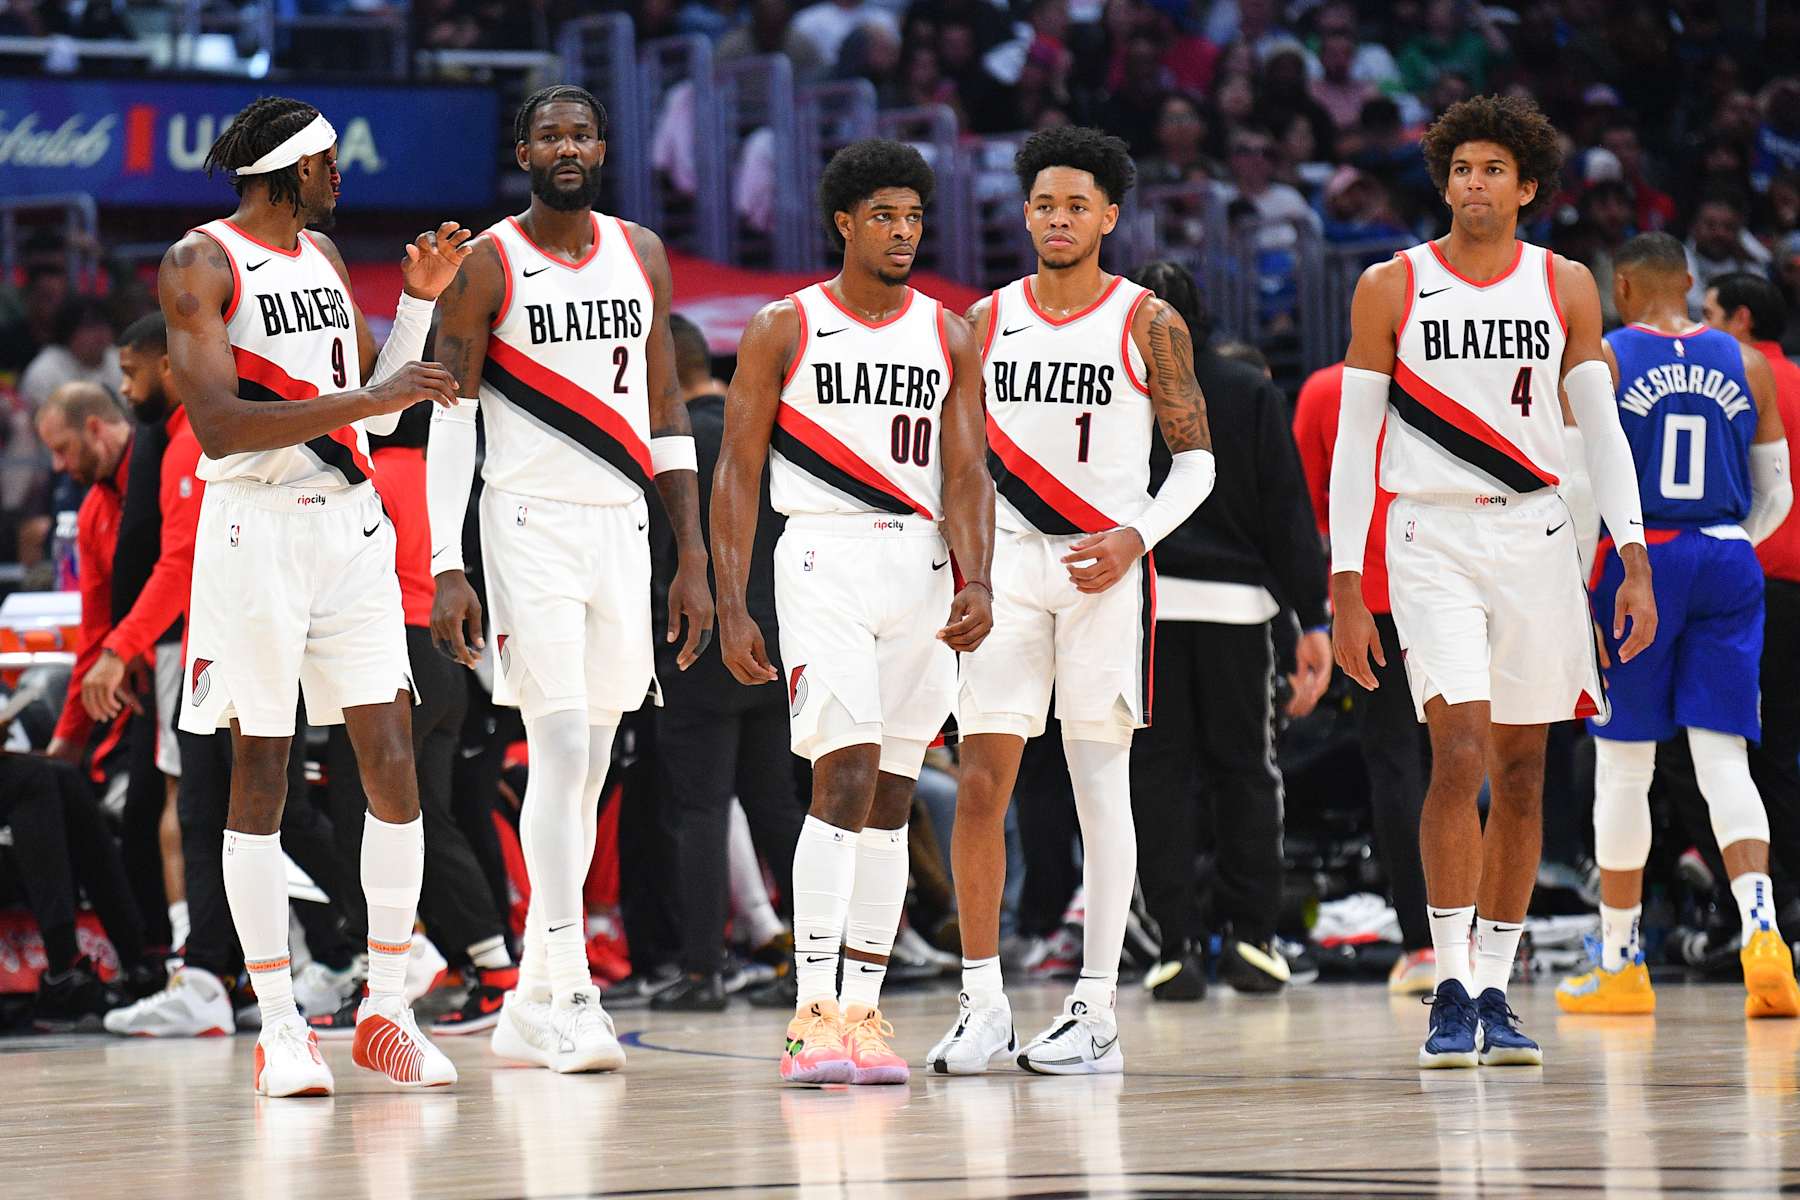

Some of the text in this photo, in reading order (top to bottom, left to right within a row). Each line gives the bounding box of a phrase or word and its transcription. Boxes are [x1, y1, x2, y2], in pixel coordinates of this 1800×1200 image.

[255, 287, 350, 337] BLAZERS
[524, 298, 642, 345] BLAZERS
[331, 337, 347, 389] 9
[1419, 319, 1551, 361] BLAZERS
[612, 346, 629, 394] 2
[811, 362, 940, 410] BLAZERS
[993, 361, 1115, 406] BLAZERS
[1511, 366, 1533, 417] 4
[1620, 363, 1751, 421] WESTBROOK
[890, 414, 932, 467] 00
[1075, 412, 1093, 463] 1
[1660, 413, 1706, 500] 0
[873, 519, 904, 531] ripcity
